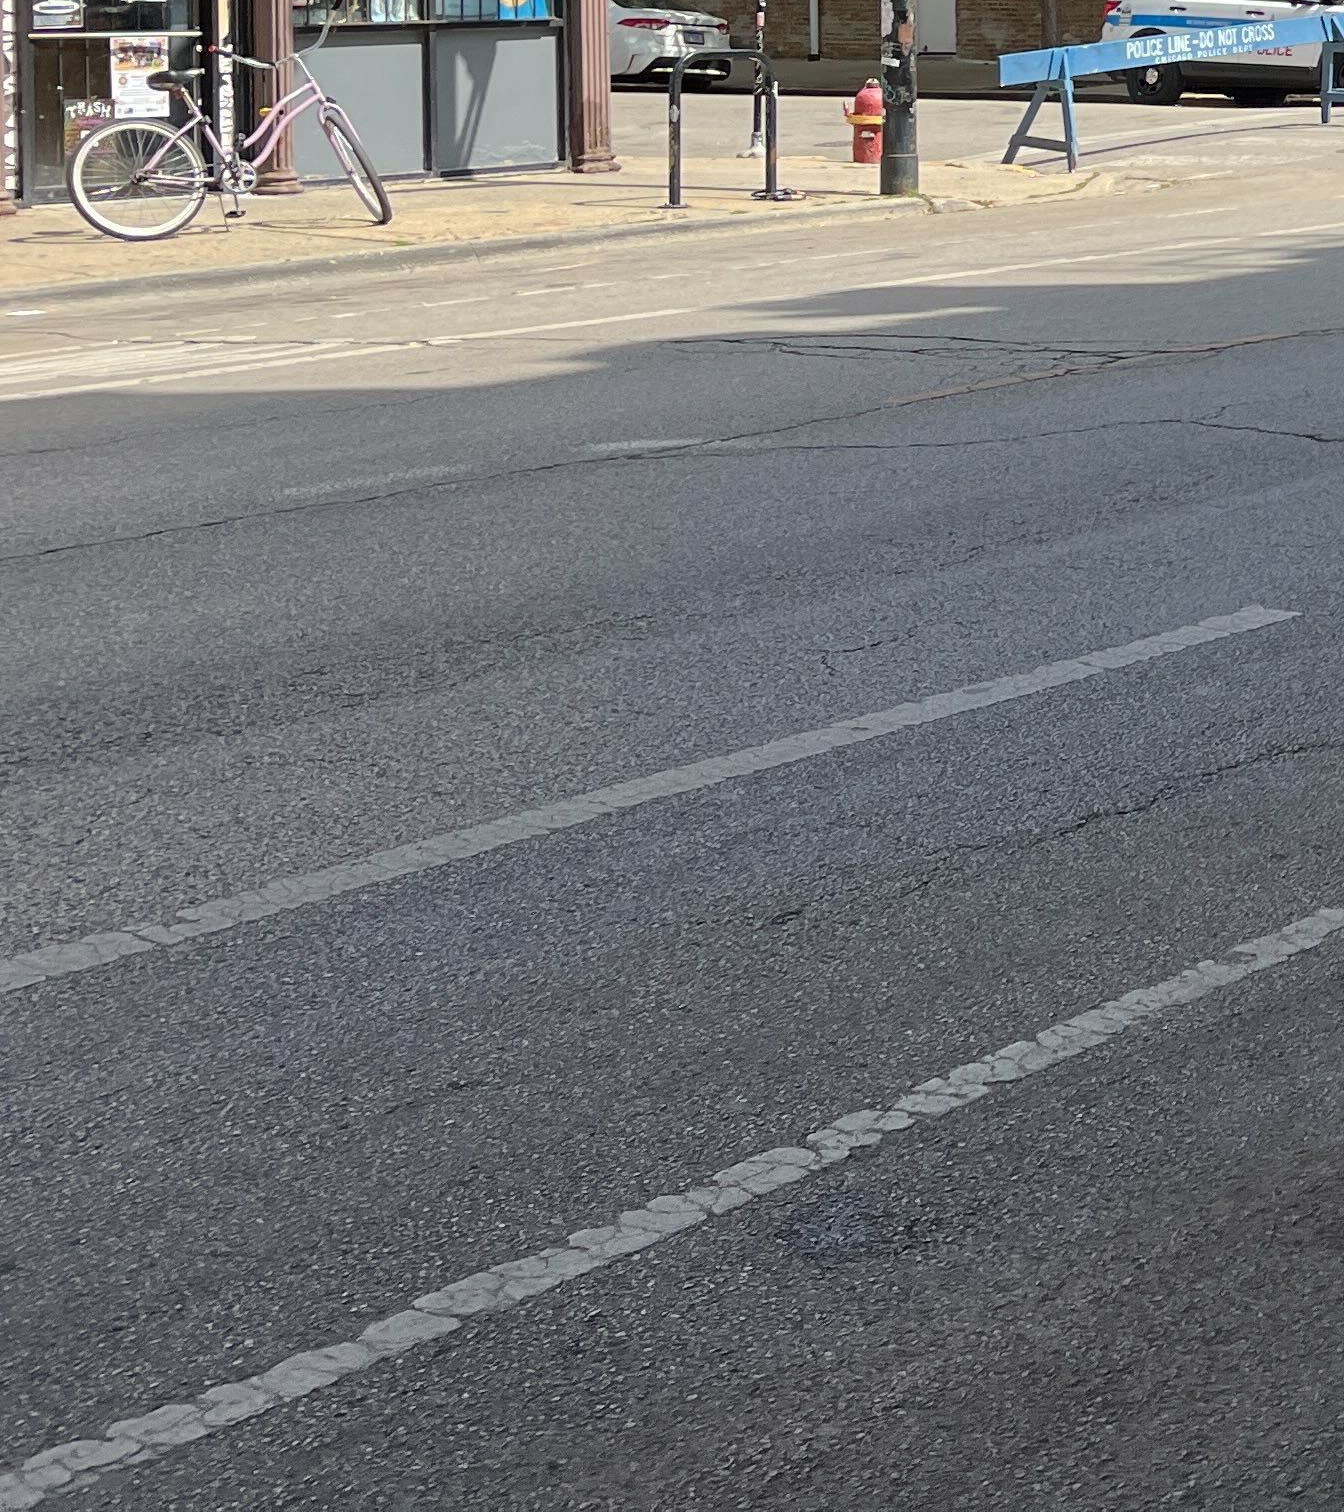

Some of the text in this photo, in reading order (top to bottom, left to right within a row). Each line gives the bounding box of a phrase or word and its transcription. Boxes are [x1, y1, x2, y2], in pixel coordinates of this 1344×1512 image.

[1126, 38, 1164, 60] POLICE
[1217, 28, 1238, 47] NOT
[1241, 23, 1275, 44] CROSS
[1197, 46, 1228, 59] POLICE
[65, 100, 112, 119] TRASH
